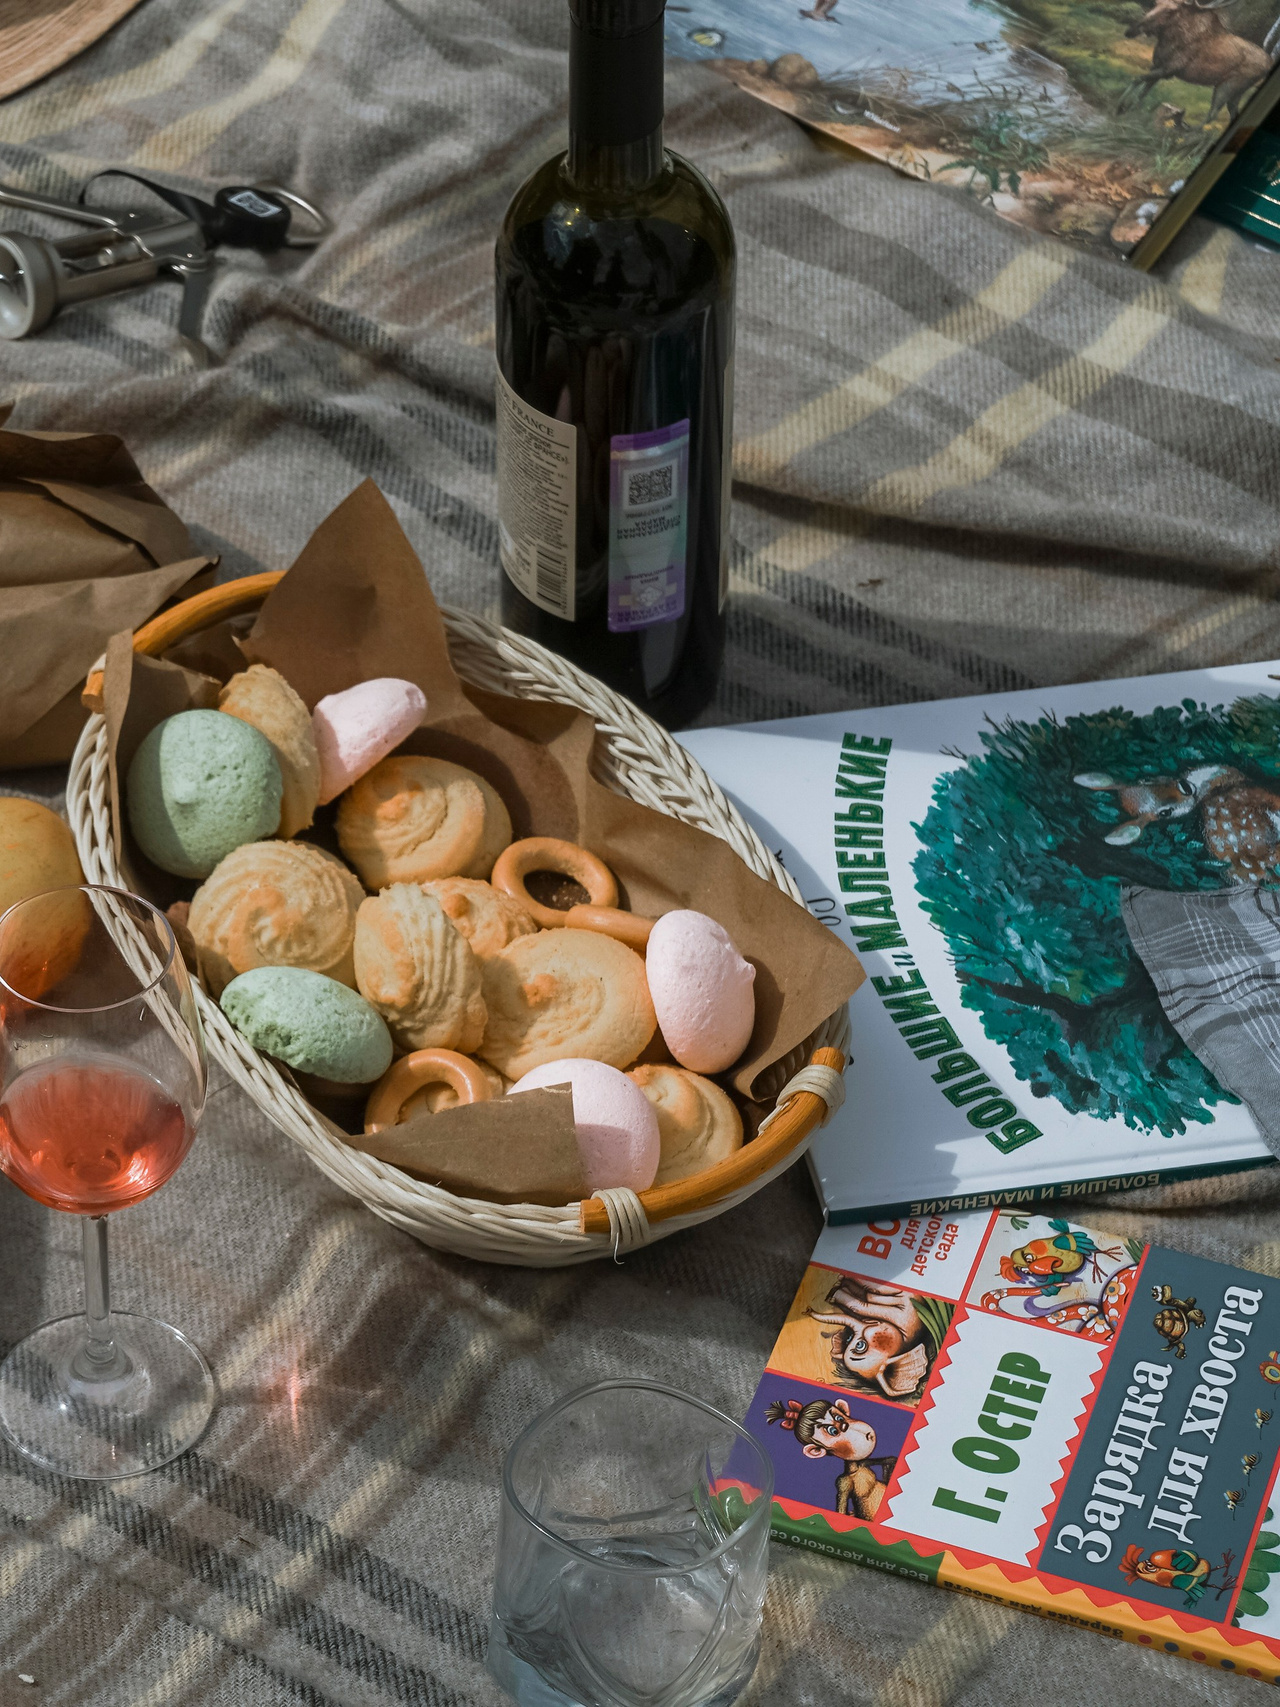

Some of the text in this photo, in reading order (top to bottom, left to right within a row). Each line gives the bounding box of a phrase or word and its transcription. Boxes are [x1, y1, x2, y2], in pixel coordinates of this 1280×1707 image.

[512, 400, 555, 437] FRANCE
[834, 731, 911, 953] МАЛЕНЬКИЕ
[871, 969, 1044, 1155] БОЛЬШИЕ
[910, 1172, 1160, 1216] БОЛЬШИЕ И МАЛЕНЬКИЕ
[857, 1215, 901, 1260] ВС
[900, 1217, 921, 1250] для
[911, 1211, 943, 1276] детског
[934, 1223, 959, 1262] сада
[1146, 1285, 1264, 1544] для хвоста
[1054, 1361, 1173, 1563] Зарядка
[931, 1484, 1009, 1524] Г.
[791, 1535, 863, 1561] детского
[866, 1556, 896, 1571] для
[943, 1580, 1124, 1638] Зарядка для хвоста
